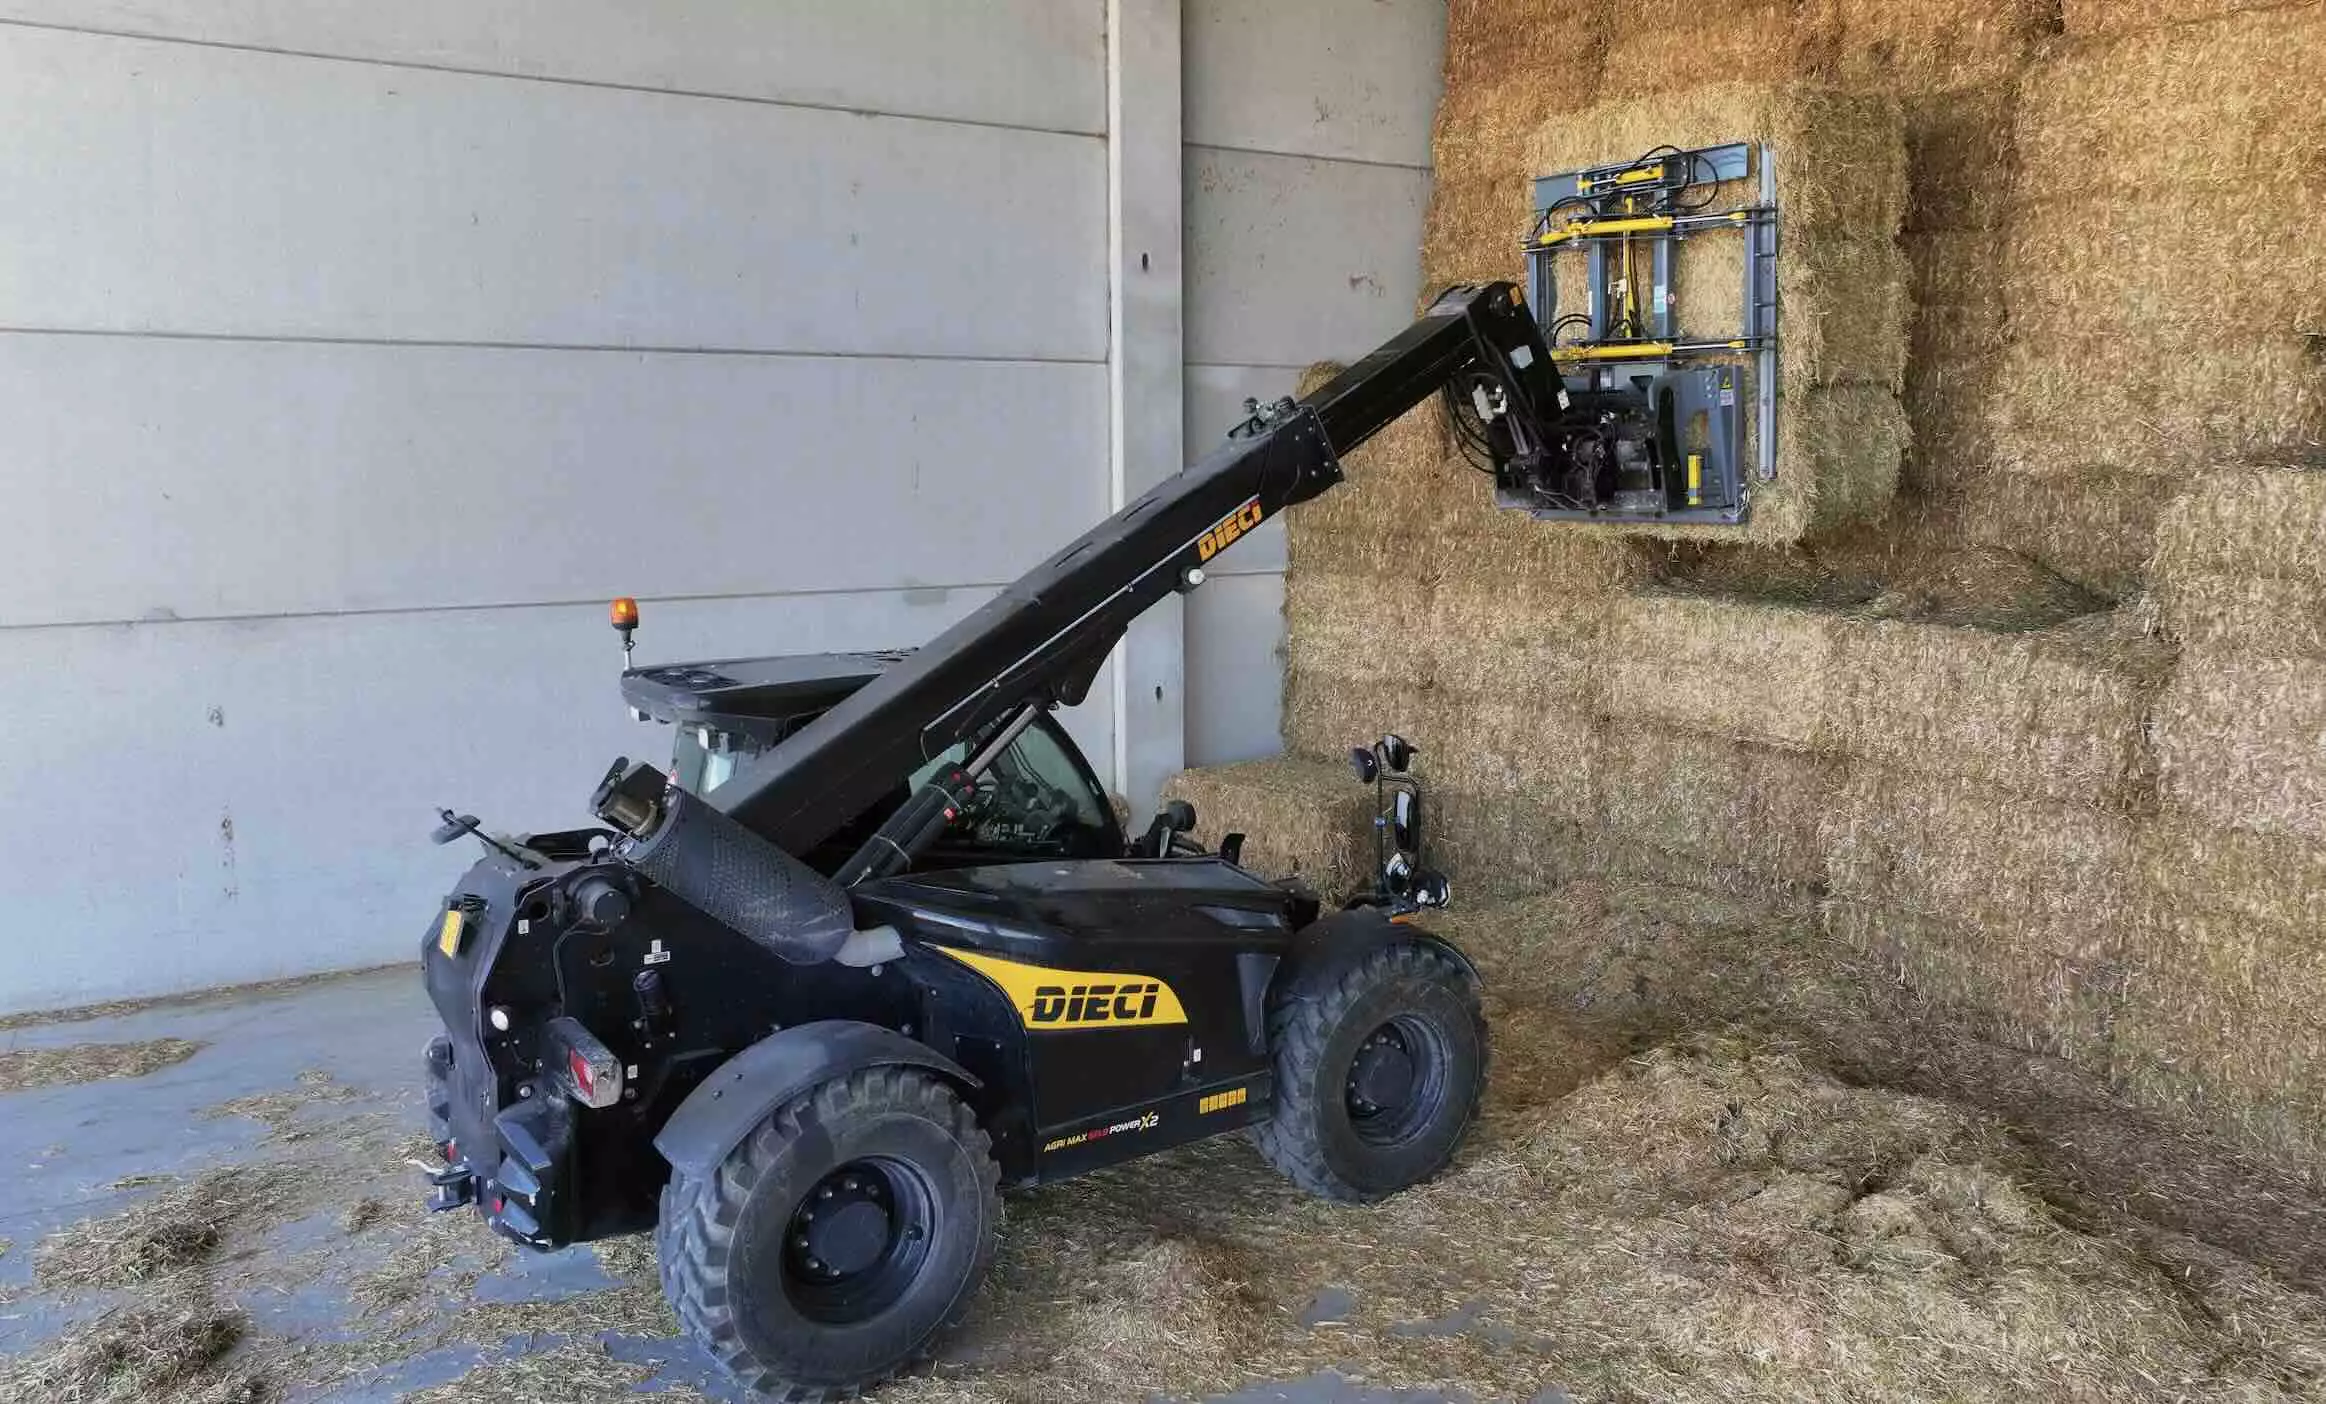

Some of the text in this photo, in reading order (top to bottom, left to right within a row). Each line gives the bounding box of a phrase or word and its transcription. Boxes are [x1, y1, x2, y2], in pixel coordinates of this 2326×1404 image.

[1198, 502, 1263, 561] DIECI
[1032, 984, 1159, 1022] DIECI
[1043, 1139, 1066, 1152] AGRI
[1067, 1132, 1088, 1146] MAX
[1109, 1119, 1141, 1134] POWER
